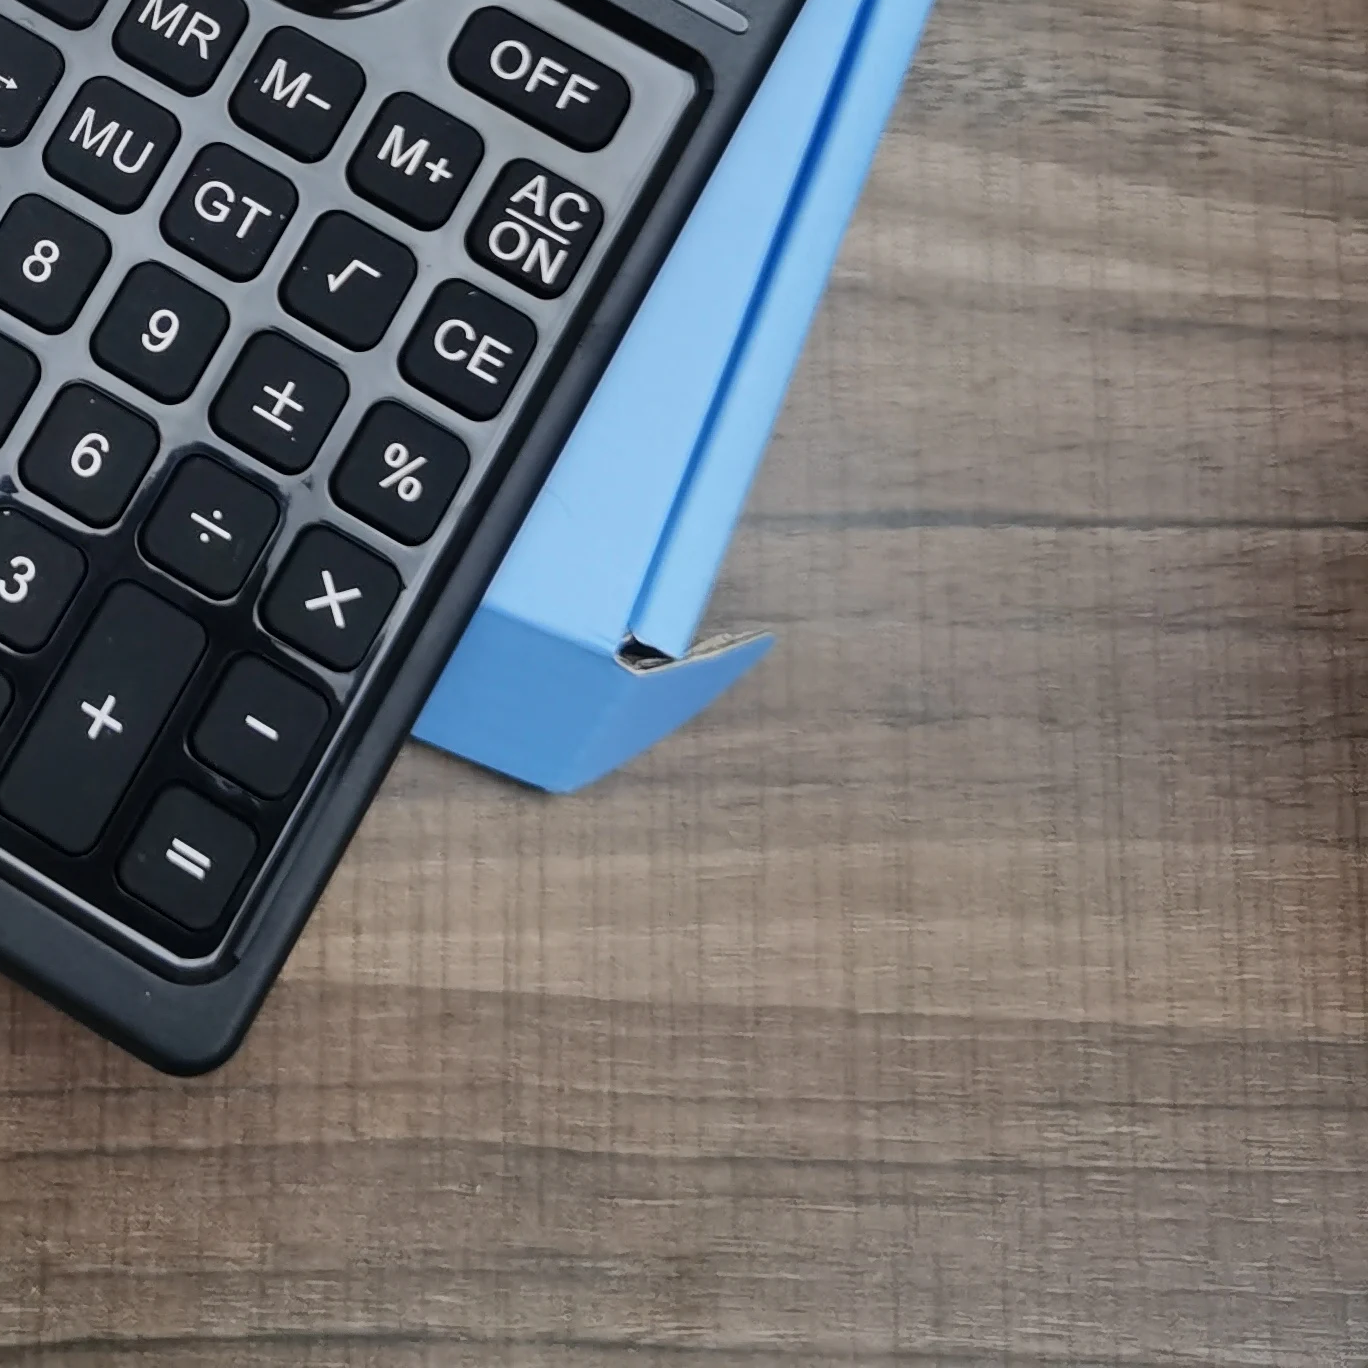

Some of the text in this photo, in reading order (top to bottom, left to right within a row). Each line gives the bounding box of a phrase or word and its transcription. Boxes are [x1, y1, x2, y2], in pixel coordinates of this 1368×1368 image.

[260, 59, 330, 109] M-
[488, 40, 598, 110] OFF
[69, 108, 154, 173] MU
[377, 125, 452, 182] M+
[195, 181, 272, 238] GT
[510, 175, 590, 232] AC
[23, 240, 59, 282] 8
[487, 222, 568, 283] ON
[142, 310, 179, 352] 9
[435, 319, 512, 383] CE
[71, 433, 109, 477] 6
[379, 443, 426, 501] %
